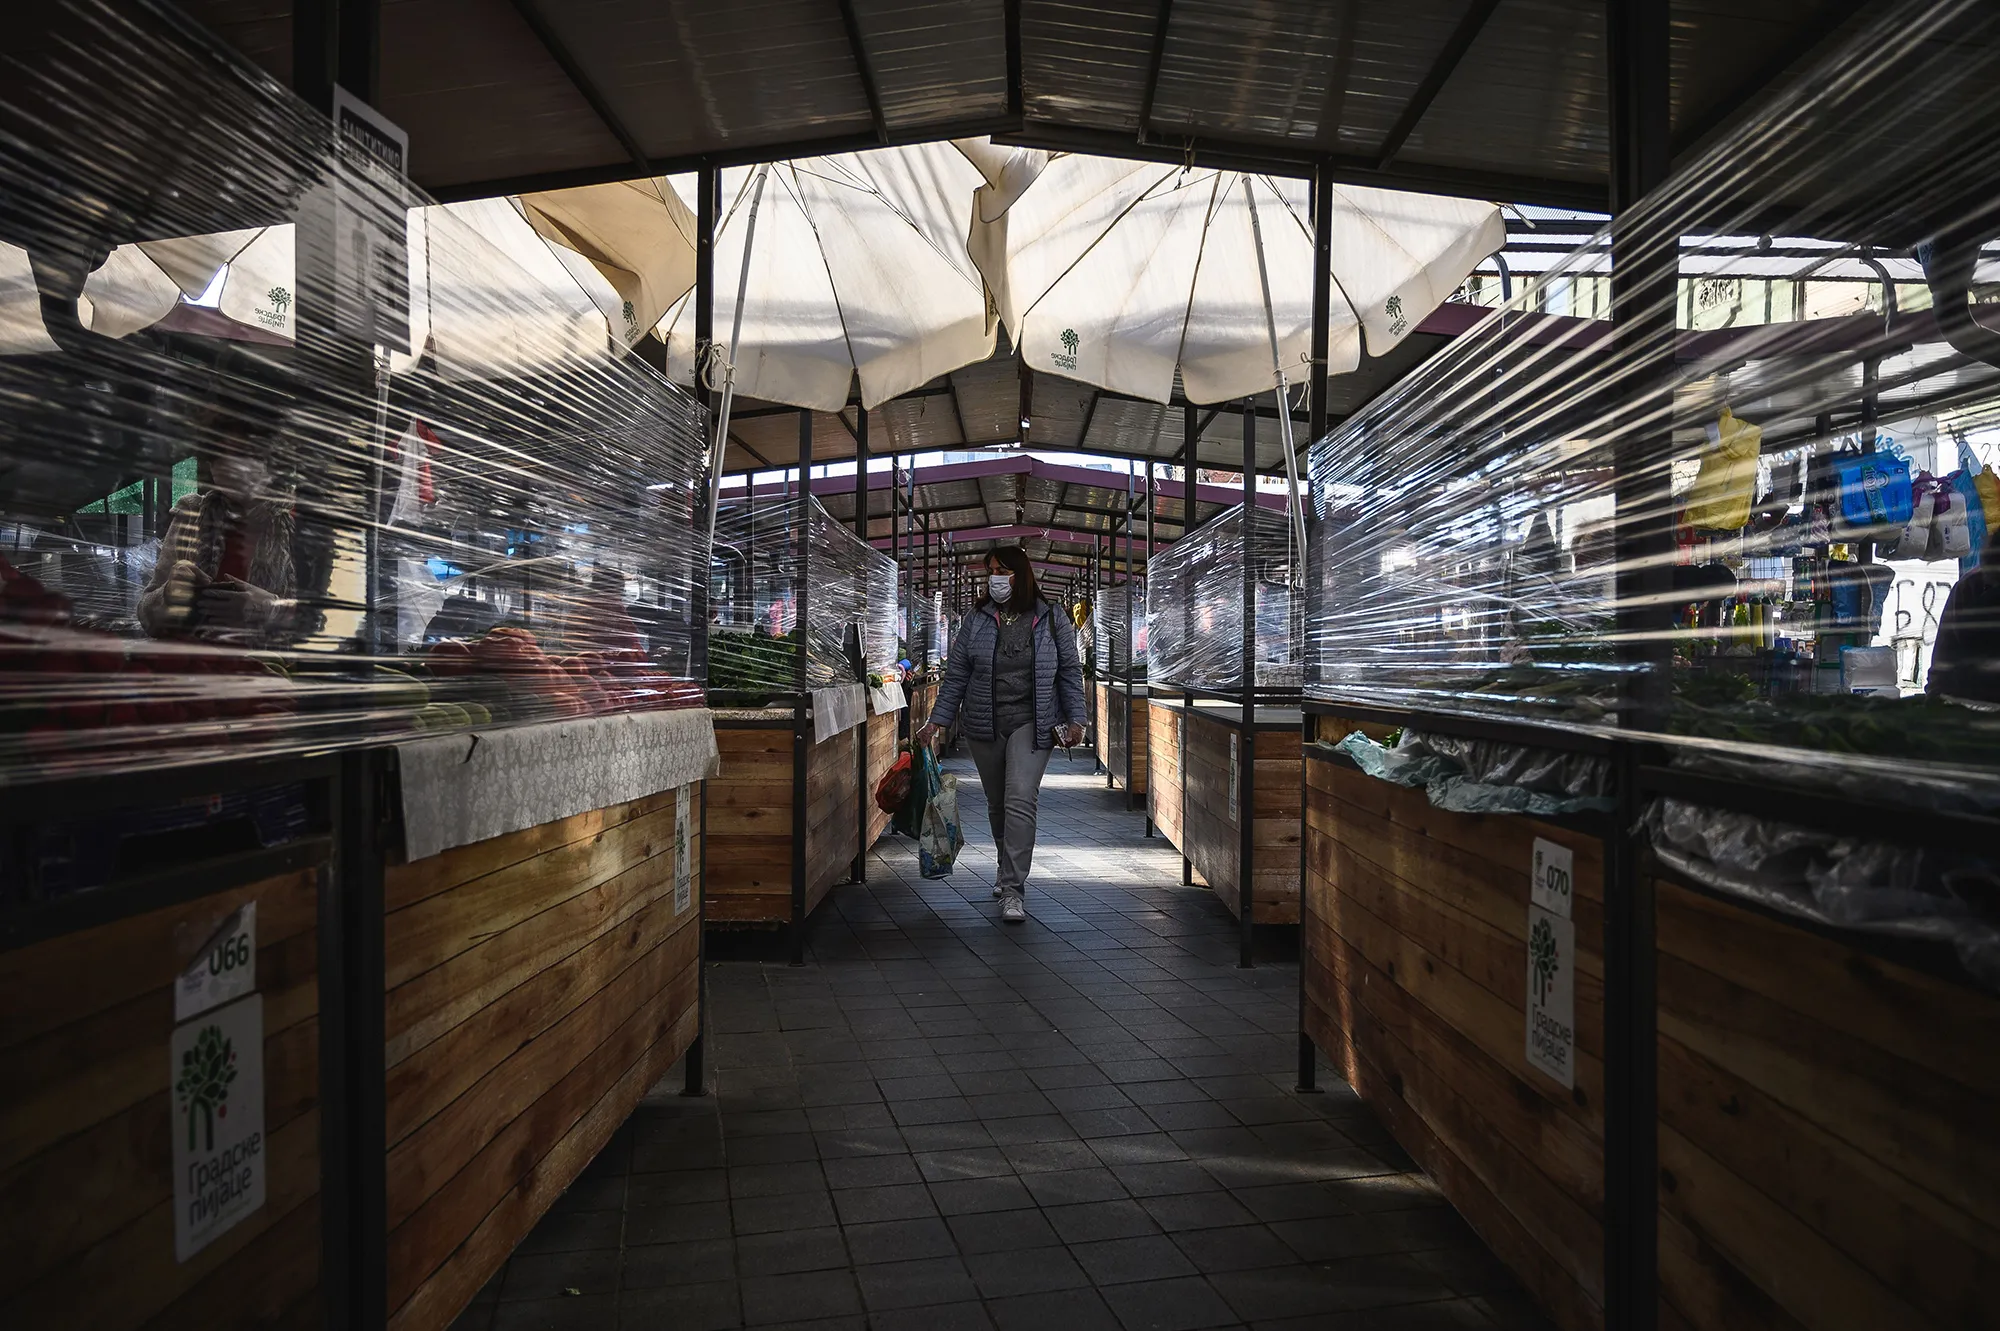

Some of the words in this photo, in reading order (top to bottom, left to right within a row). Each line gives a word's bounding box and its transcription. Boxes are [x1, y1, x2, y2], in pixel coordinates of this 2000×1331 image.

[1546, 865, 1569, 896] 070
[209, 932, 249, 976] 066
[1532, 1002, 1572, 1050] Градске
[1532, 1030, 1566, 1072] пијаце
[188, 1131, 261, 1197] Градске
[188, 1166, 253, 1227] пијаце
